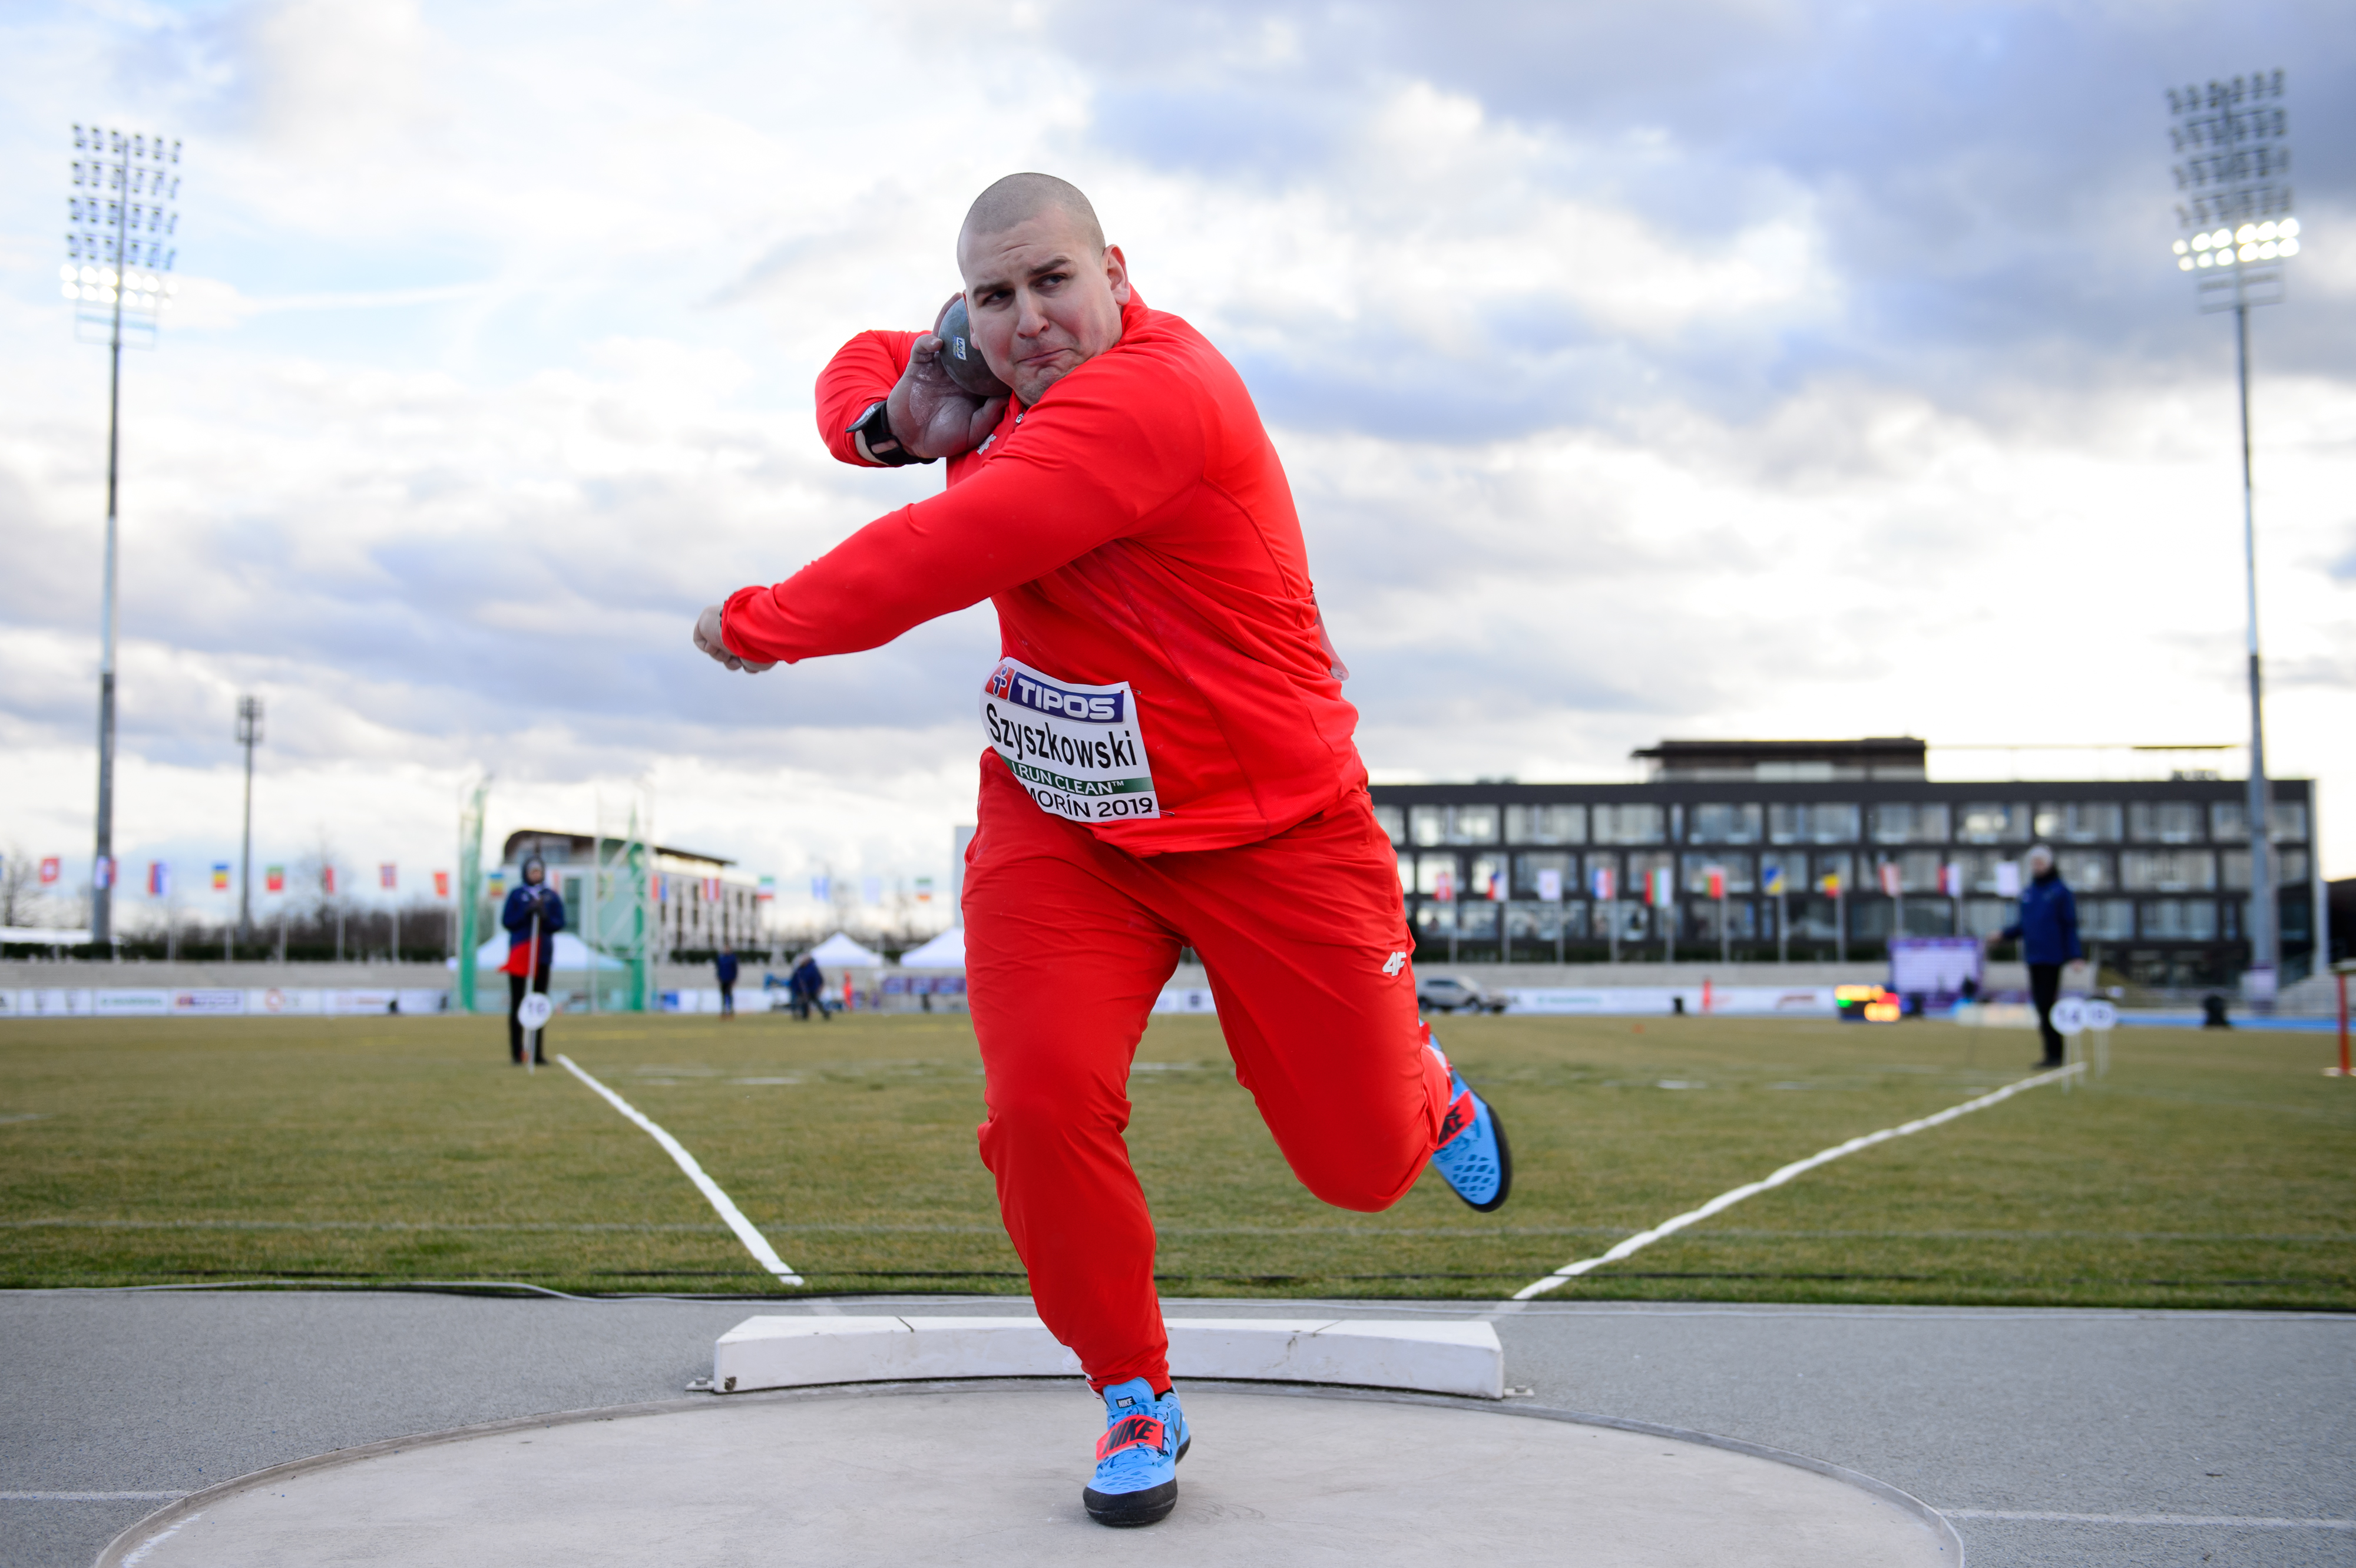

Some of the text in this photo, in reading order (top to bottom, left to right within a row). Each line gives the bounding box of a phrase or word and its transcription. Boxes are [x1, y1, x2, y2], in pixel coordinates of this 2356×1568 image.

[1017, 677, 1116, 720] TIPOS
[986, 703, 1137, 769] Szyszkowski
[1011, 761, 1017, 774] I
[1018, 763, 1053, 786] RUN
[1097, 797, 1153, 818] 2019
[1382, 951, 1407, 977] 4F
[1118, 1398, 1133, 1408] NIKE
[1102, 1418, 1158, 1455] NIKE
